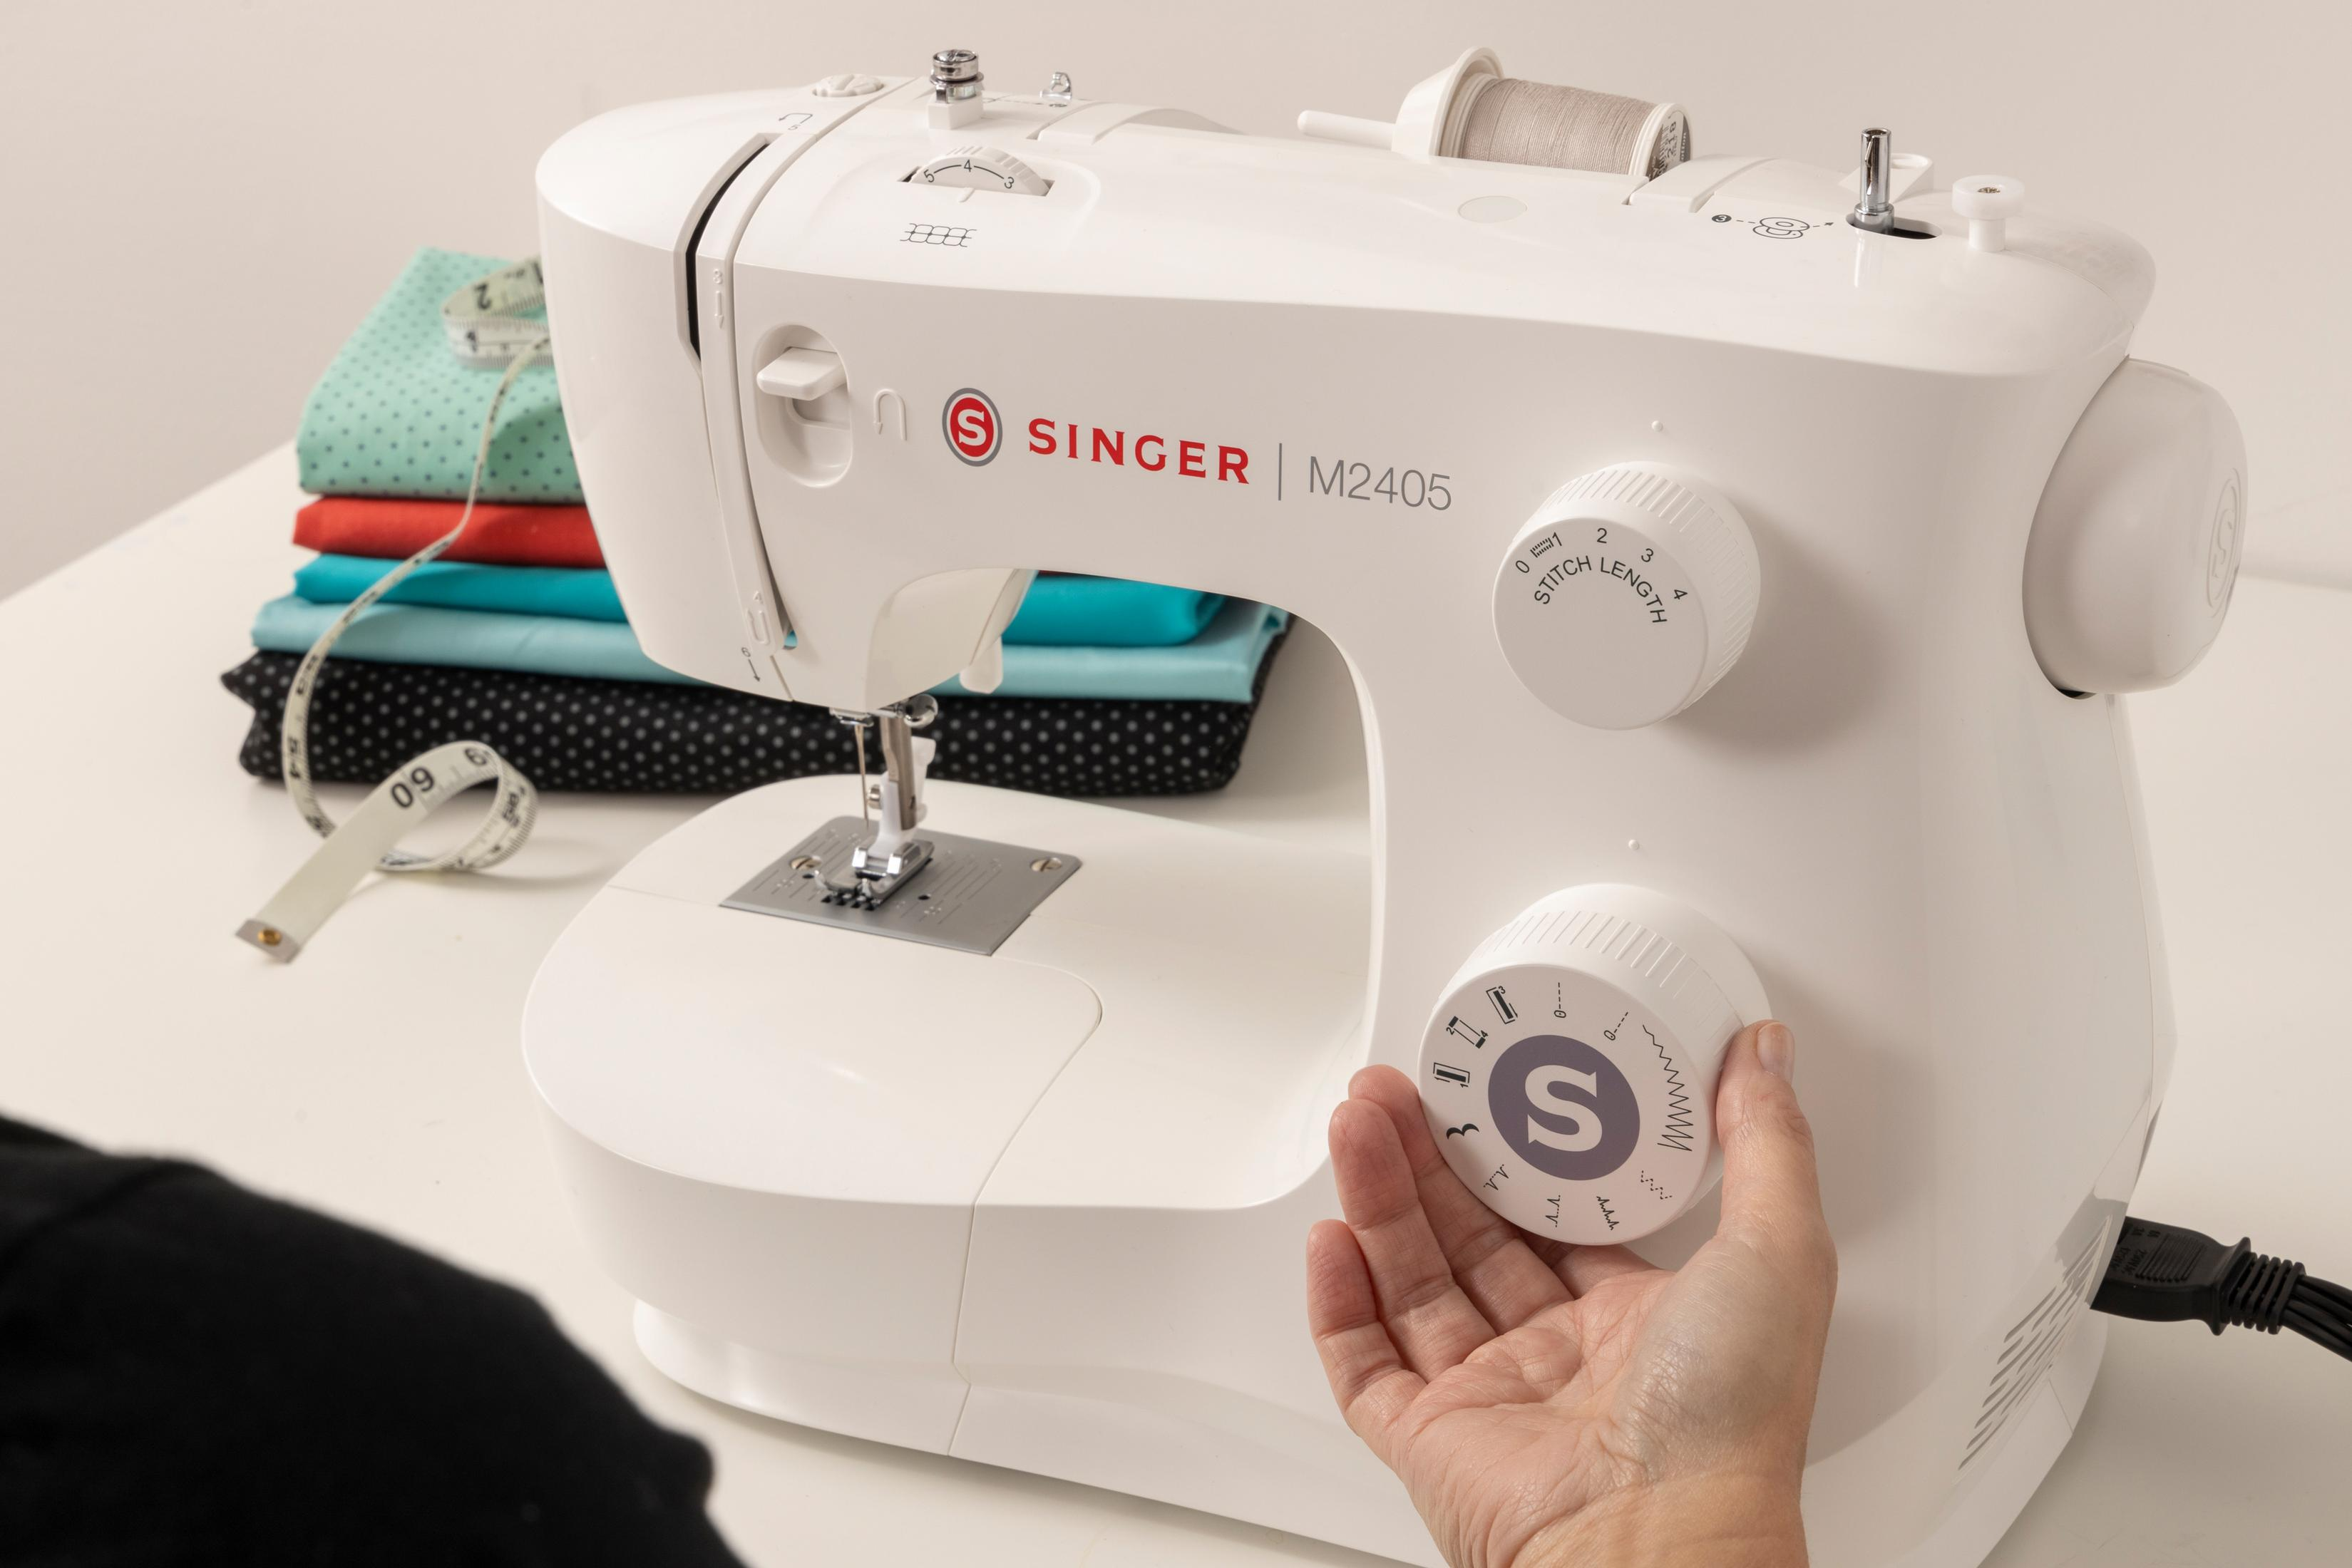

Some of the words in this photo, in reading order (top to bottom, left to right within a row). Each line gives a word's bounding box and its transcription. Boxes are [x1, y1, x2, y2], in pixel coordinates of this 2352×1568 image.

[923, 169, 935, 183] 5
[964, 159, 972, 172] 4
[1004, 176, 1015, 189] 3
[1028, 418, 1250, 485] SINGER
[1310, 456, 1452, 511] M2405
[1515, 559, 1530, 574] 0
[1552, 532, 1563, 547] 1
[1596, 527, 1608, 544] 2
[1640, 548, 1654, 563] 3
[1673, 589, 1688, 600] 4
[1534, 555, 1592, 604] STITCH
[1601, 557, 1668, 623] LENGTH
[741, 647, 751, 657] 6
[391, 768, 435, 810] 60
[1498, 986, 1506, 994] 3
[1446, 1026, 1455, 1036] 2
[1524, 1064, 1603, 1152] S
